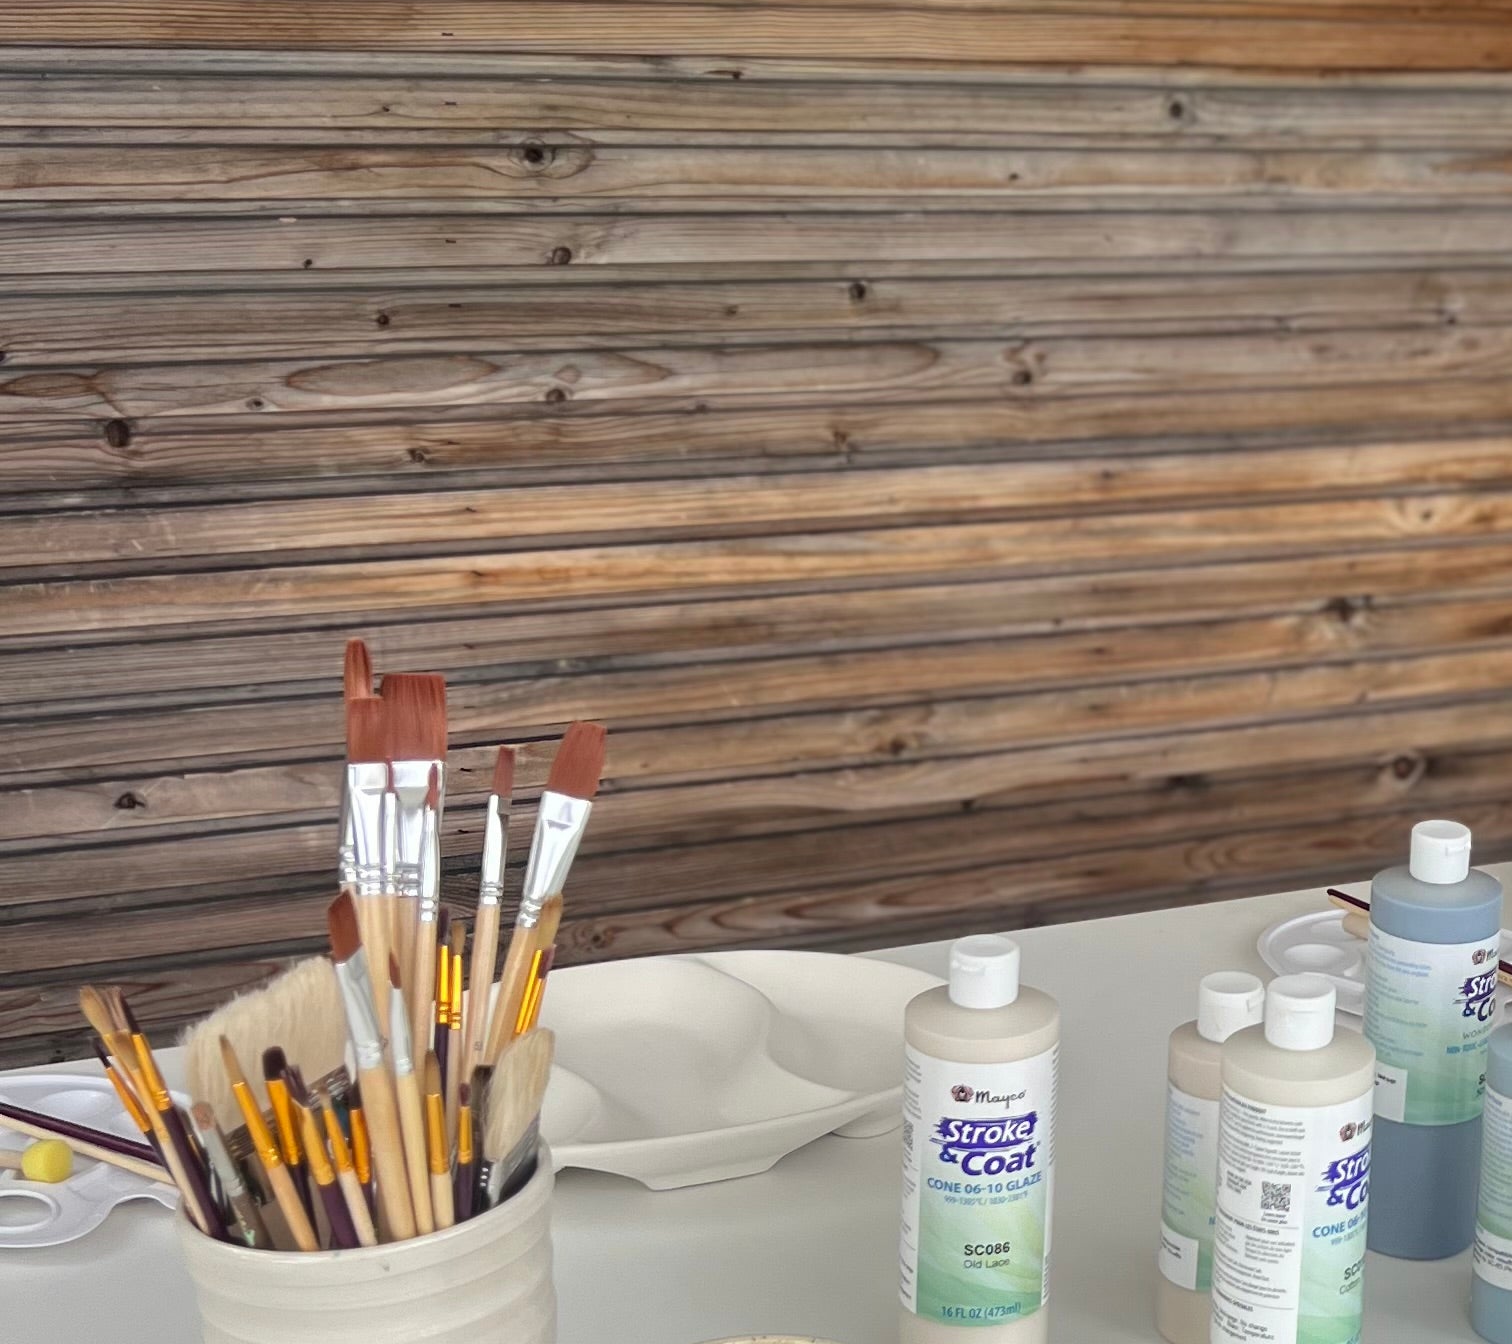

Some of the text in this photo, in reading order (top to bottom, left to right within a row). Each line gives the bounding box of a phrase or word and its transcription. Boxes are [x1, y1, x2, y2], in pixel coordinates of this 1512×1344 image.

[1467, 974, 1496, 998] Stro
[1462, 997, 1497, 1022] & Co
[975, 1089, 1027, 1109] Mayco
[946, 1118, 1031, 1144] Stroke
[939, 1143, 1037, 1176] & Coat
[1333, 1151, 1369, 1184] Stro
[927, 1171, 1042, 1194] CONE 06-10 GLAZE
[1326, 1179, 1369, 1210] & Co
[1312, 1221, 1346, 1238] CONE
[964, 1241, 1011, 1256] SC086
[963, 1258, 1010, 1269] Old Lace
[942, 1302, 1022, 1319] 16 FL OZ (473ml)
